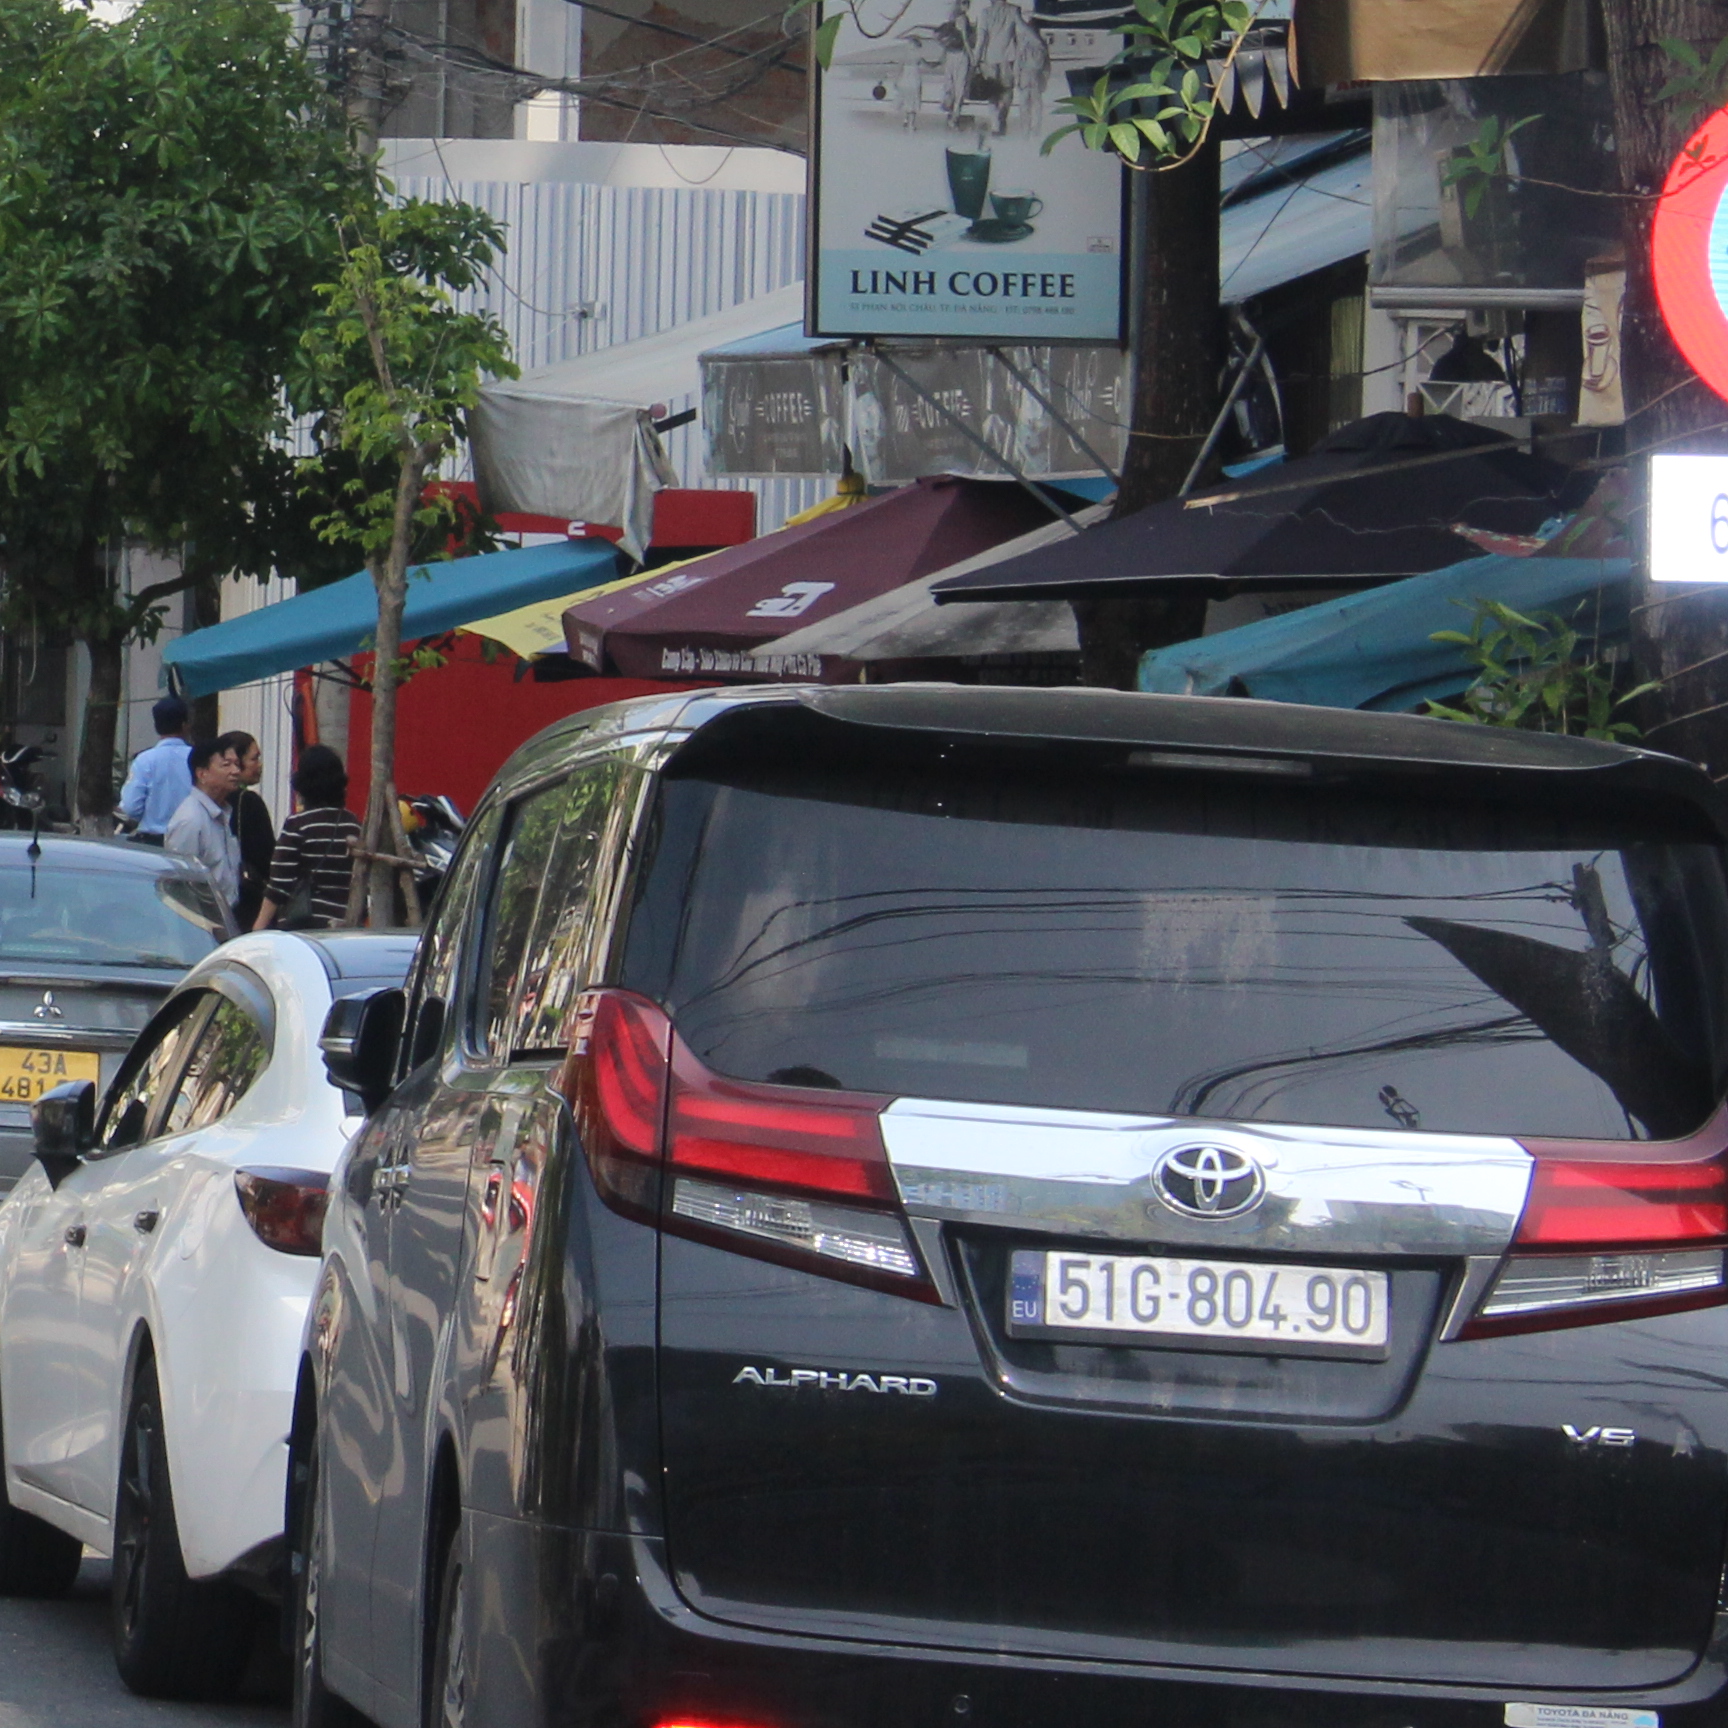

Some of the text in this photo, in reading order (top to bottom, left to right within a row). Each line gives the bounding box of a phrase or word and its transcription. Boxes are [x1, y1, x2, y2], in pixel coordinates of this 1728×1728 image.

[850, 269, 1075, 298] LINH COFFEE
[21, 1050, 67, 1076] 43A
[1012, 1300, 1037, 1318] EU
[1059, 1258, 1373, 1335] 51G-804.90
[732, 1365, 938, 1397] ALPHARD
[1560, 1423, 1636, 1448] V6
[1537, 1706, 1580, 1718] TOYOTA
